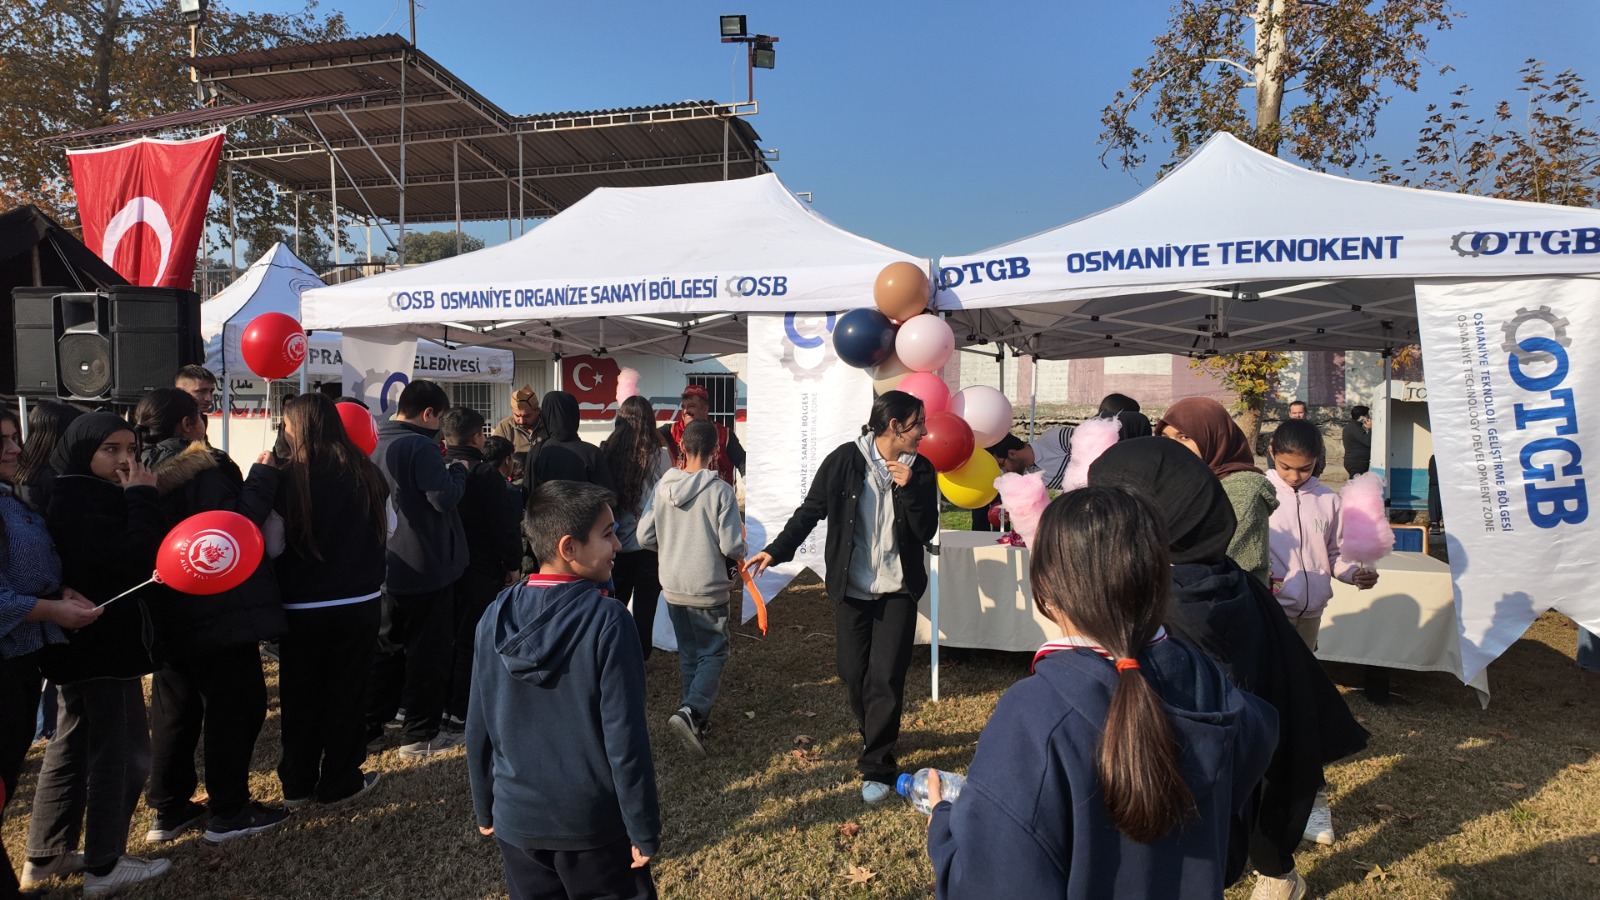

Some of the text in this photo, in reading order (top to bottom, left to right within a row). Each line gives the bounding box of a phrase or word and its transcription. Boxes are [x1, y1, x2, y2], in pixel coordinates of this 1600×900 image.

[939, 235, 1404, 290] OTGB OSMANİYE TEKNOKENT
[1471, 227, 1600, 257] OTGB
[397, 275, 788, 311] OSB OSMANİYE ORGANİZE SANAYİ BÖLGESİ OSB
[309, 348, 343, 365] PRA
[413, 354, 481, 373] ELEDİYESİ
[810, 392, 818, 414] ZONE
[1463, 366, 1481, 432] TECHNOLOGY
[1473, 312, 1514, 532] OSMANİYE TEKNOLOJİ GELİŞTİRME BÖLGESİ
[1507, 336, 1589, 529] OTGB
[1471, 434, 1492, 505] DEVELOPMENT
[1482, 506, 1496, 533] ZONE
